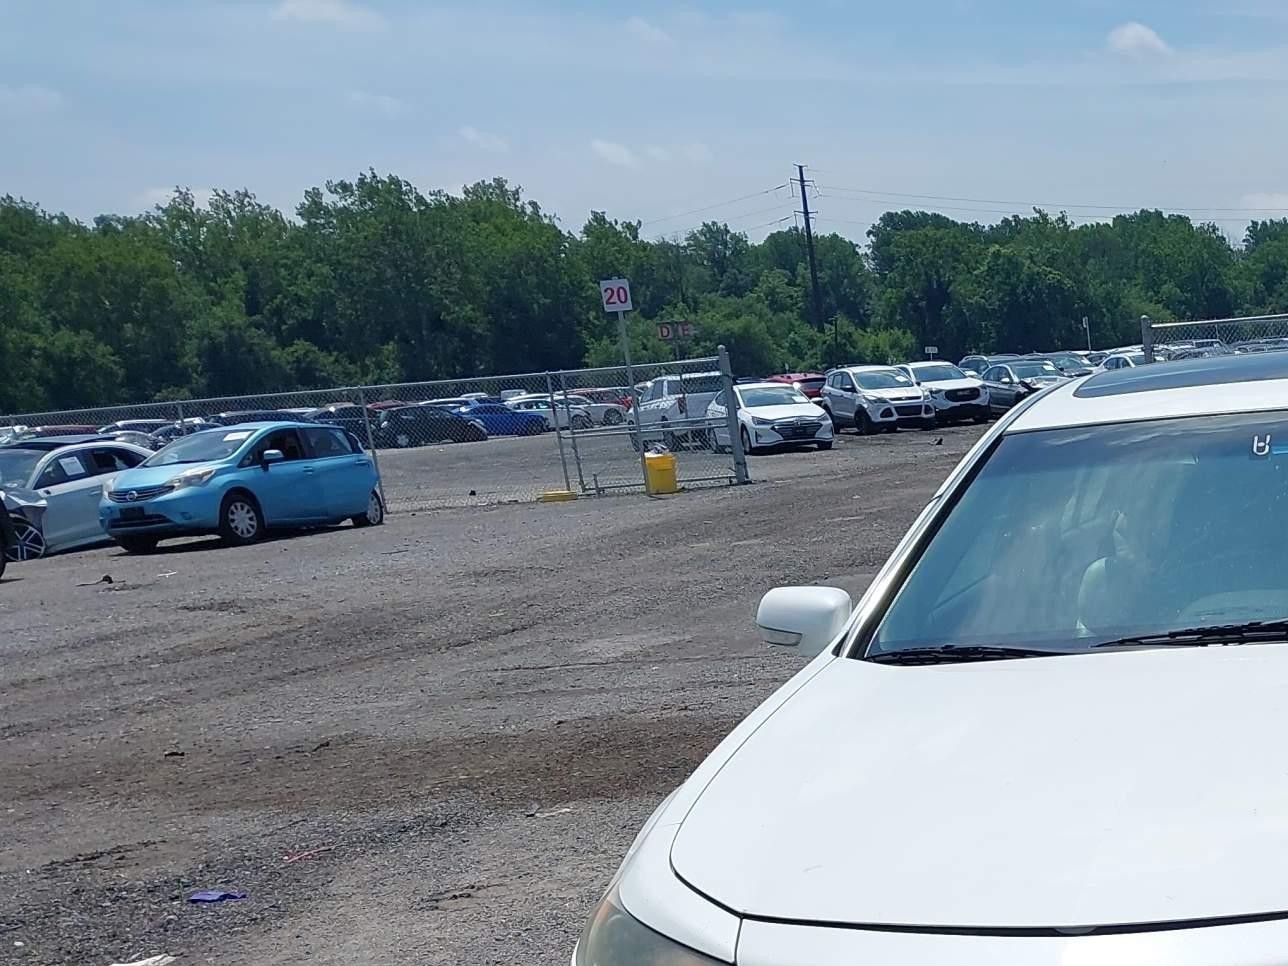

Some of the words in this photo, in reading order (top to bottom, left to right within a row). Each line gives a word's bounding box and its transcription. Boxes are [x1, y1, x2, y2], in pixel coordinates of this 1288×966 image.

[603, 286, 628, 305] 20
[660, 325, 671, 338] D
[681, 323, 691, 337] E
